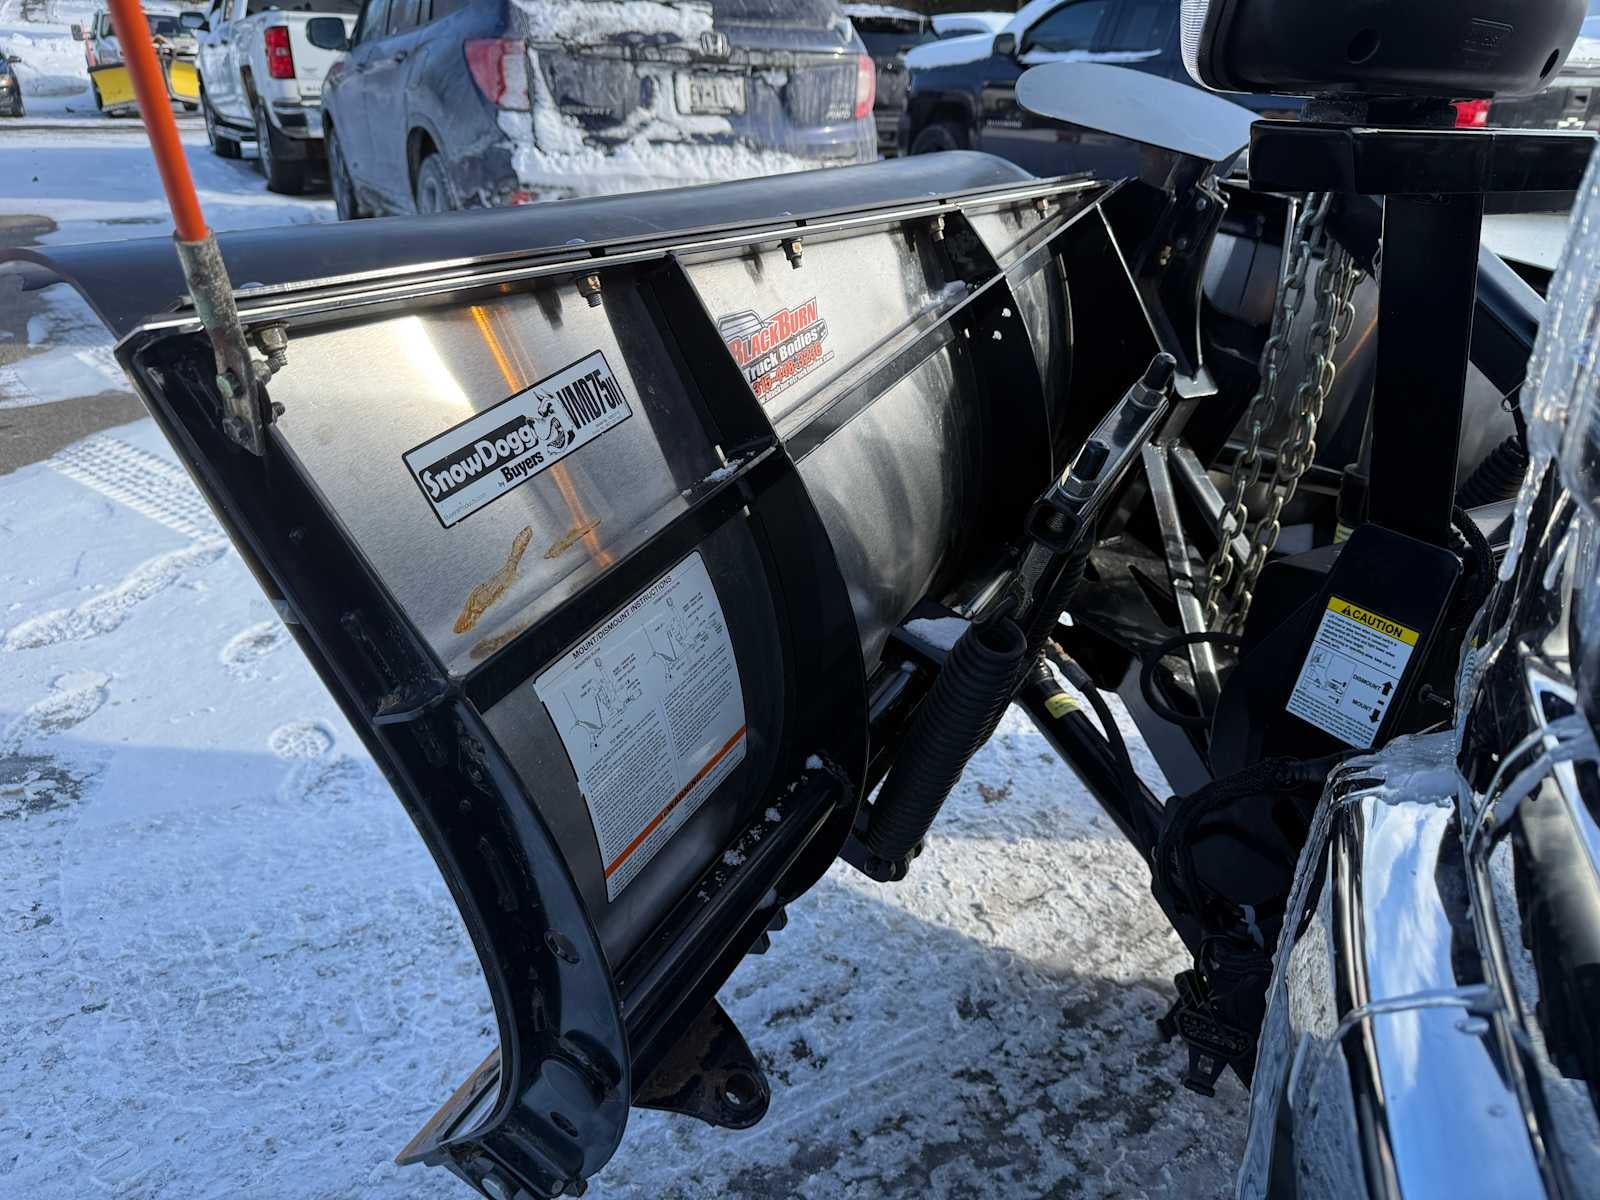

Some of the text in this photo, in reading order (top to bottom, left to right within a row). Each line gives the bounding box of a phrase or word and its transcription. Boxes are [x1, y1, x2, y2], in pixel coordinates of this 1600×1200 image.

[744, 330, 819, 382] Truck Bodies
[421, 421, 538, 499] SnowDogg
[500, 451, 544, 483] Buyers
[573, 611, 631, 660] MOUNT/DISMOUNT
[630, 576, 672, 616] INSTRUCTIONS
[1351, 609, 1404, 639] CAUTION
[1352, 674, 1382, 692] DISMOUNT
[1351, 698, 1372, 712] MOUNT
